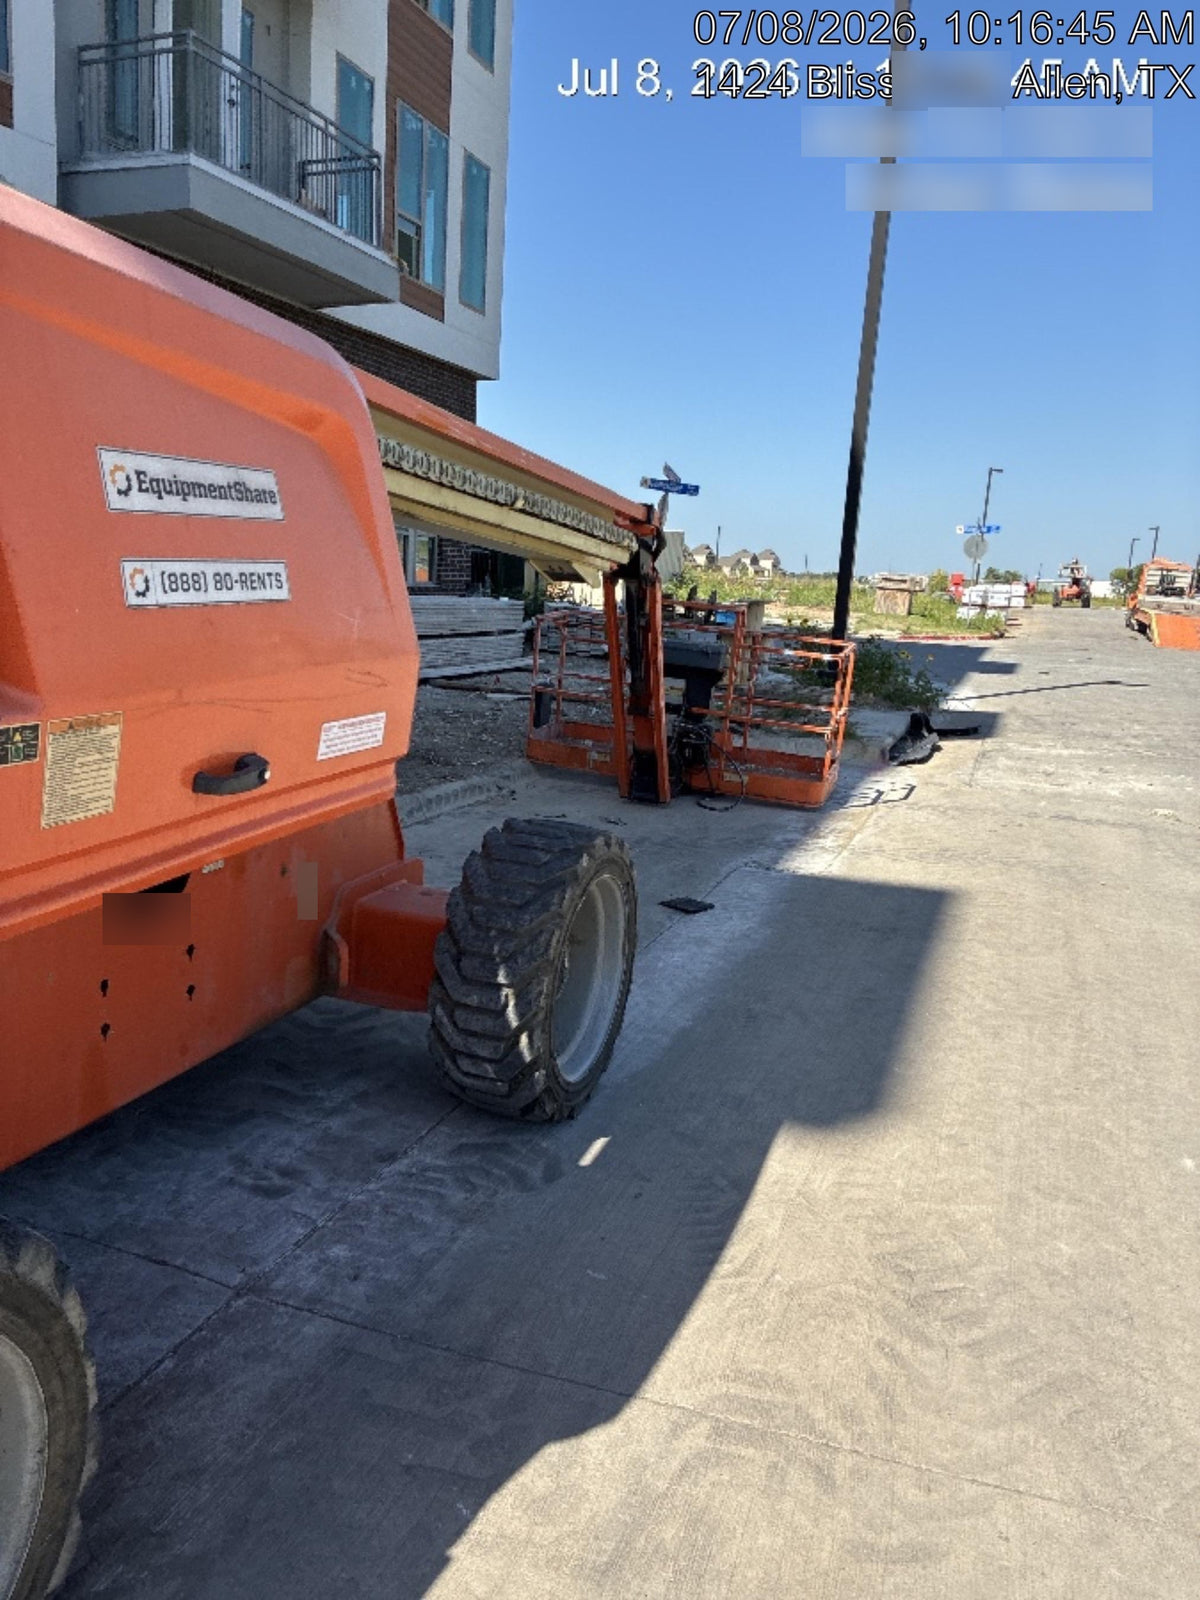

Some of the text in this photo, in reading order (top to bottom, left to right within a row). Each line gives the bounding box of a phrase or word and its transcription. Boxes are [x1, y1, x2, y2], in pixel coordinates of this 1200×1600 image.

[135, 470, 278, 505] EquipmentShare
[160, 570, 284, 594] (888) 80-RENTS
